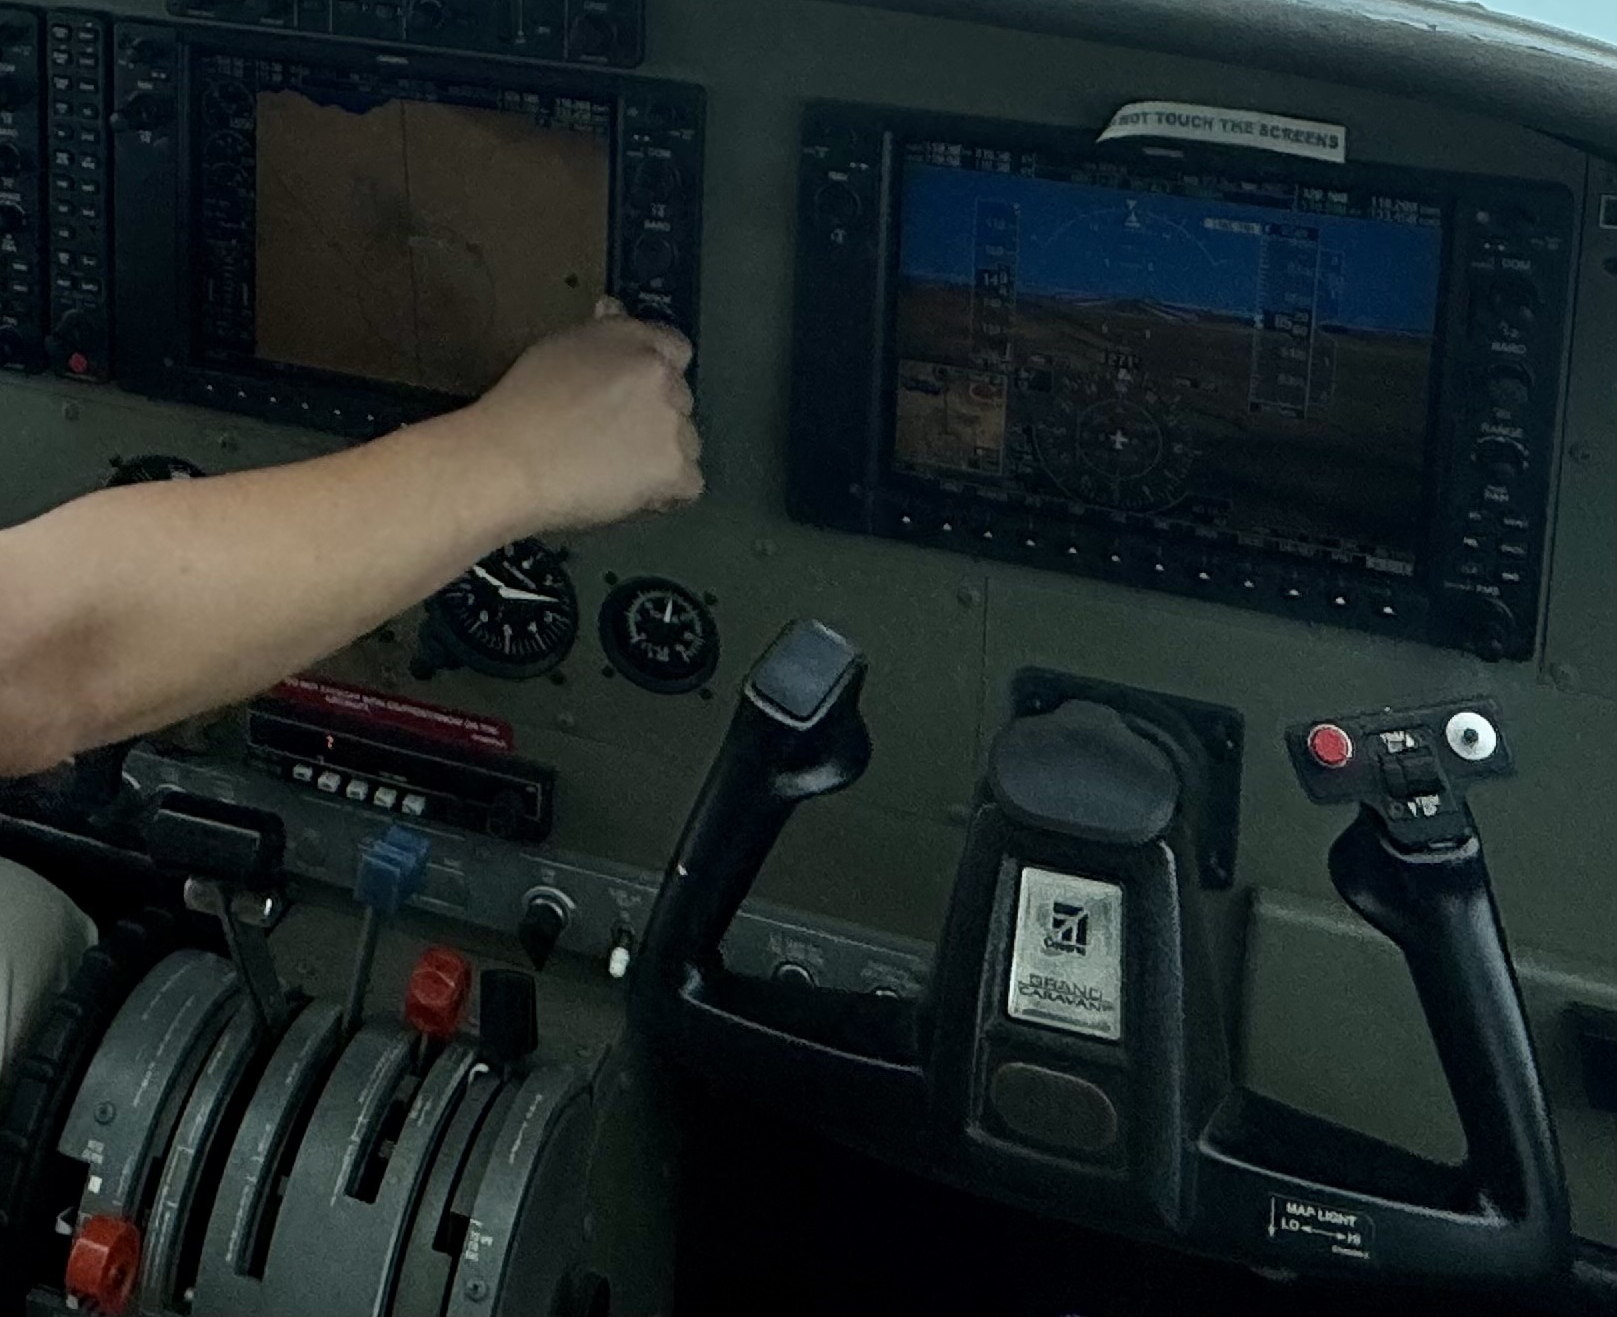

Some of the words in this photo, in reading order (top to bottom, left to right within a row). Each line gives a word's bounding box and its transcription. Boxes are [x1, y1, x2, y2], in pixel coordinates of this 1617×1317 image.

[1118, 112, 1149, 127] NOT
[1156, 111, 1214, 132] TOUCH
[1219, 118, 1254, 135] THE
[1259, 122, 1340, 150] SCREENS
[1018, 981, 1102, 1012] CARAVAN
[1029, 973, 1103, 1002] GRAND
[1286, 1201, 1317, 1218] MAP
[1318, 1207, 1358, 1228] LIGHT
[1281, 1216, 1301, 1232] LO
[1347, 1231, 1362, 1246] HI
